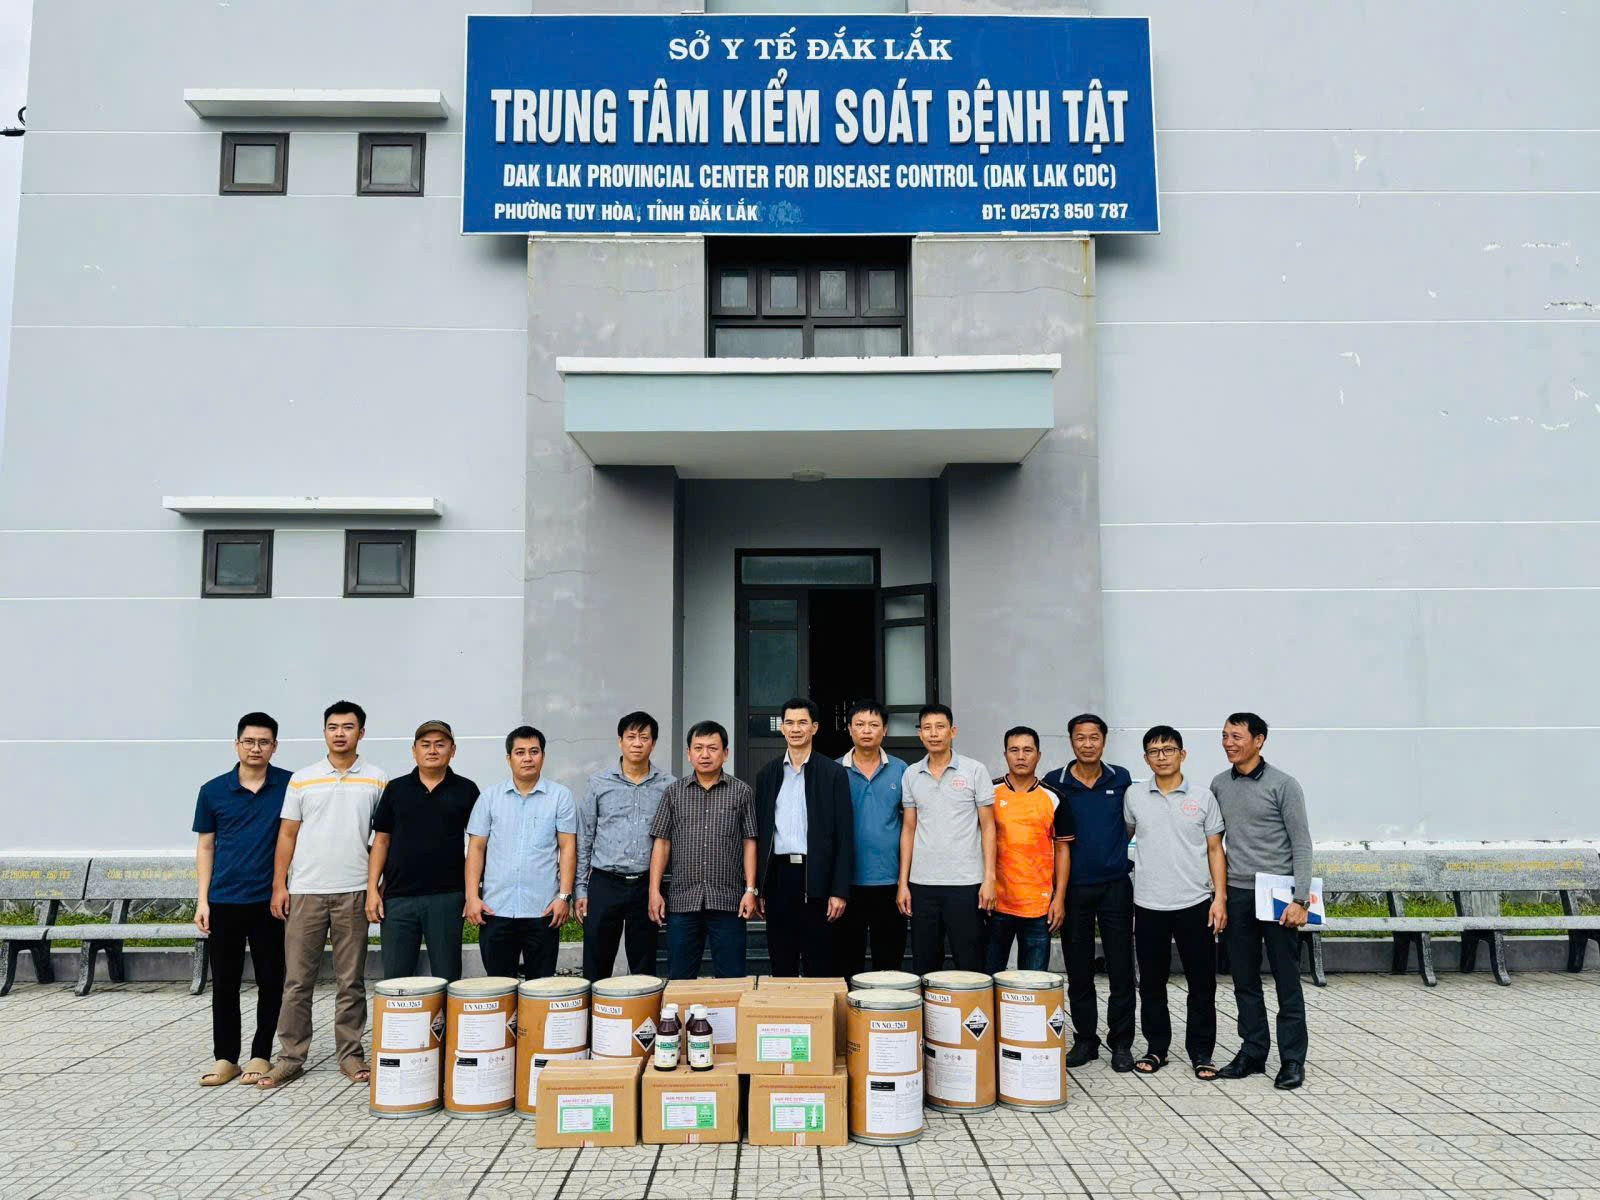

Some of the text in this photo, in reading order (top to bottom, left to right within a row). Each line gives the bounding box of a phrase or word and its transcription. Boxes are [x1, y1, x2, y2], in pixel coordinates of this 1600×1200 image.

[670, 26, 952, 60] SỞ Y TẾ ĐẮK LẮK
[491, 68, 1128, 153] TRUNG TÂM KIỂM SOÁT BỆNH TẬT
[504, 164, 1116, 189] DAK LAK PROVINCIAL CENTER FOR DISEASE CONTROL (DAK LAK CDC)
[495, 198, 757, 222] PHƯỜNG TUY HÒA, TỈNH ĐẮK LẮK
[982, 203, 1128, 219] ĐT: 02573 850 787
